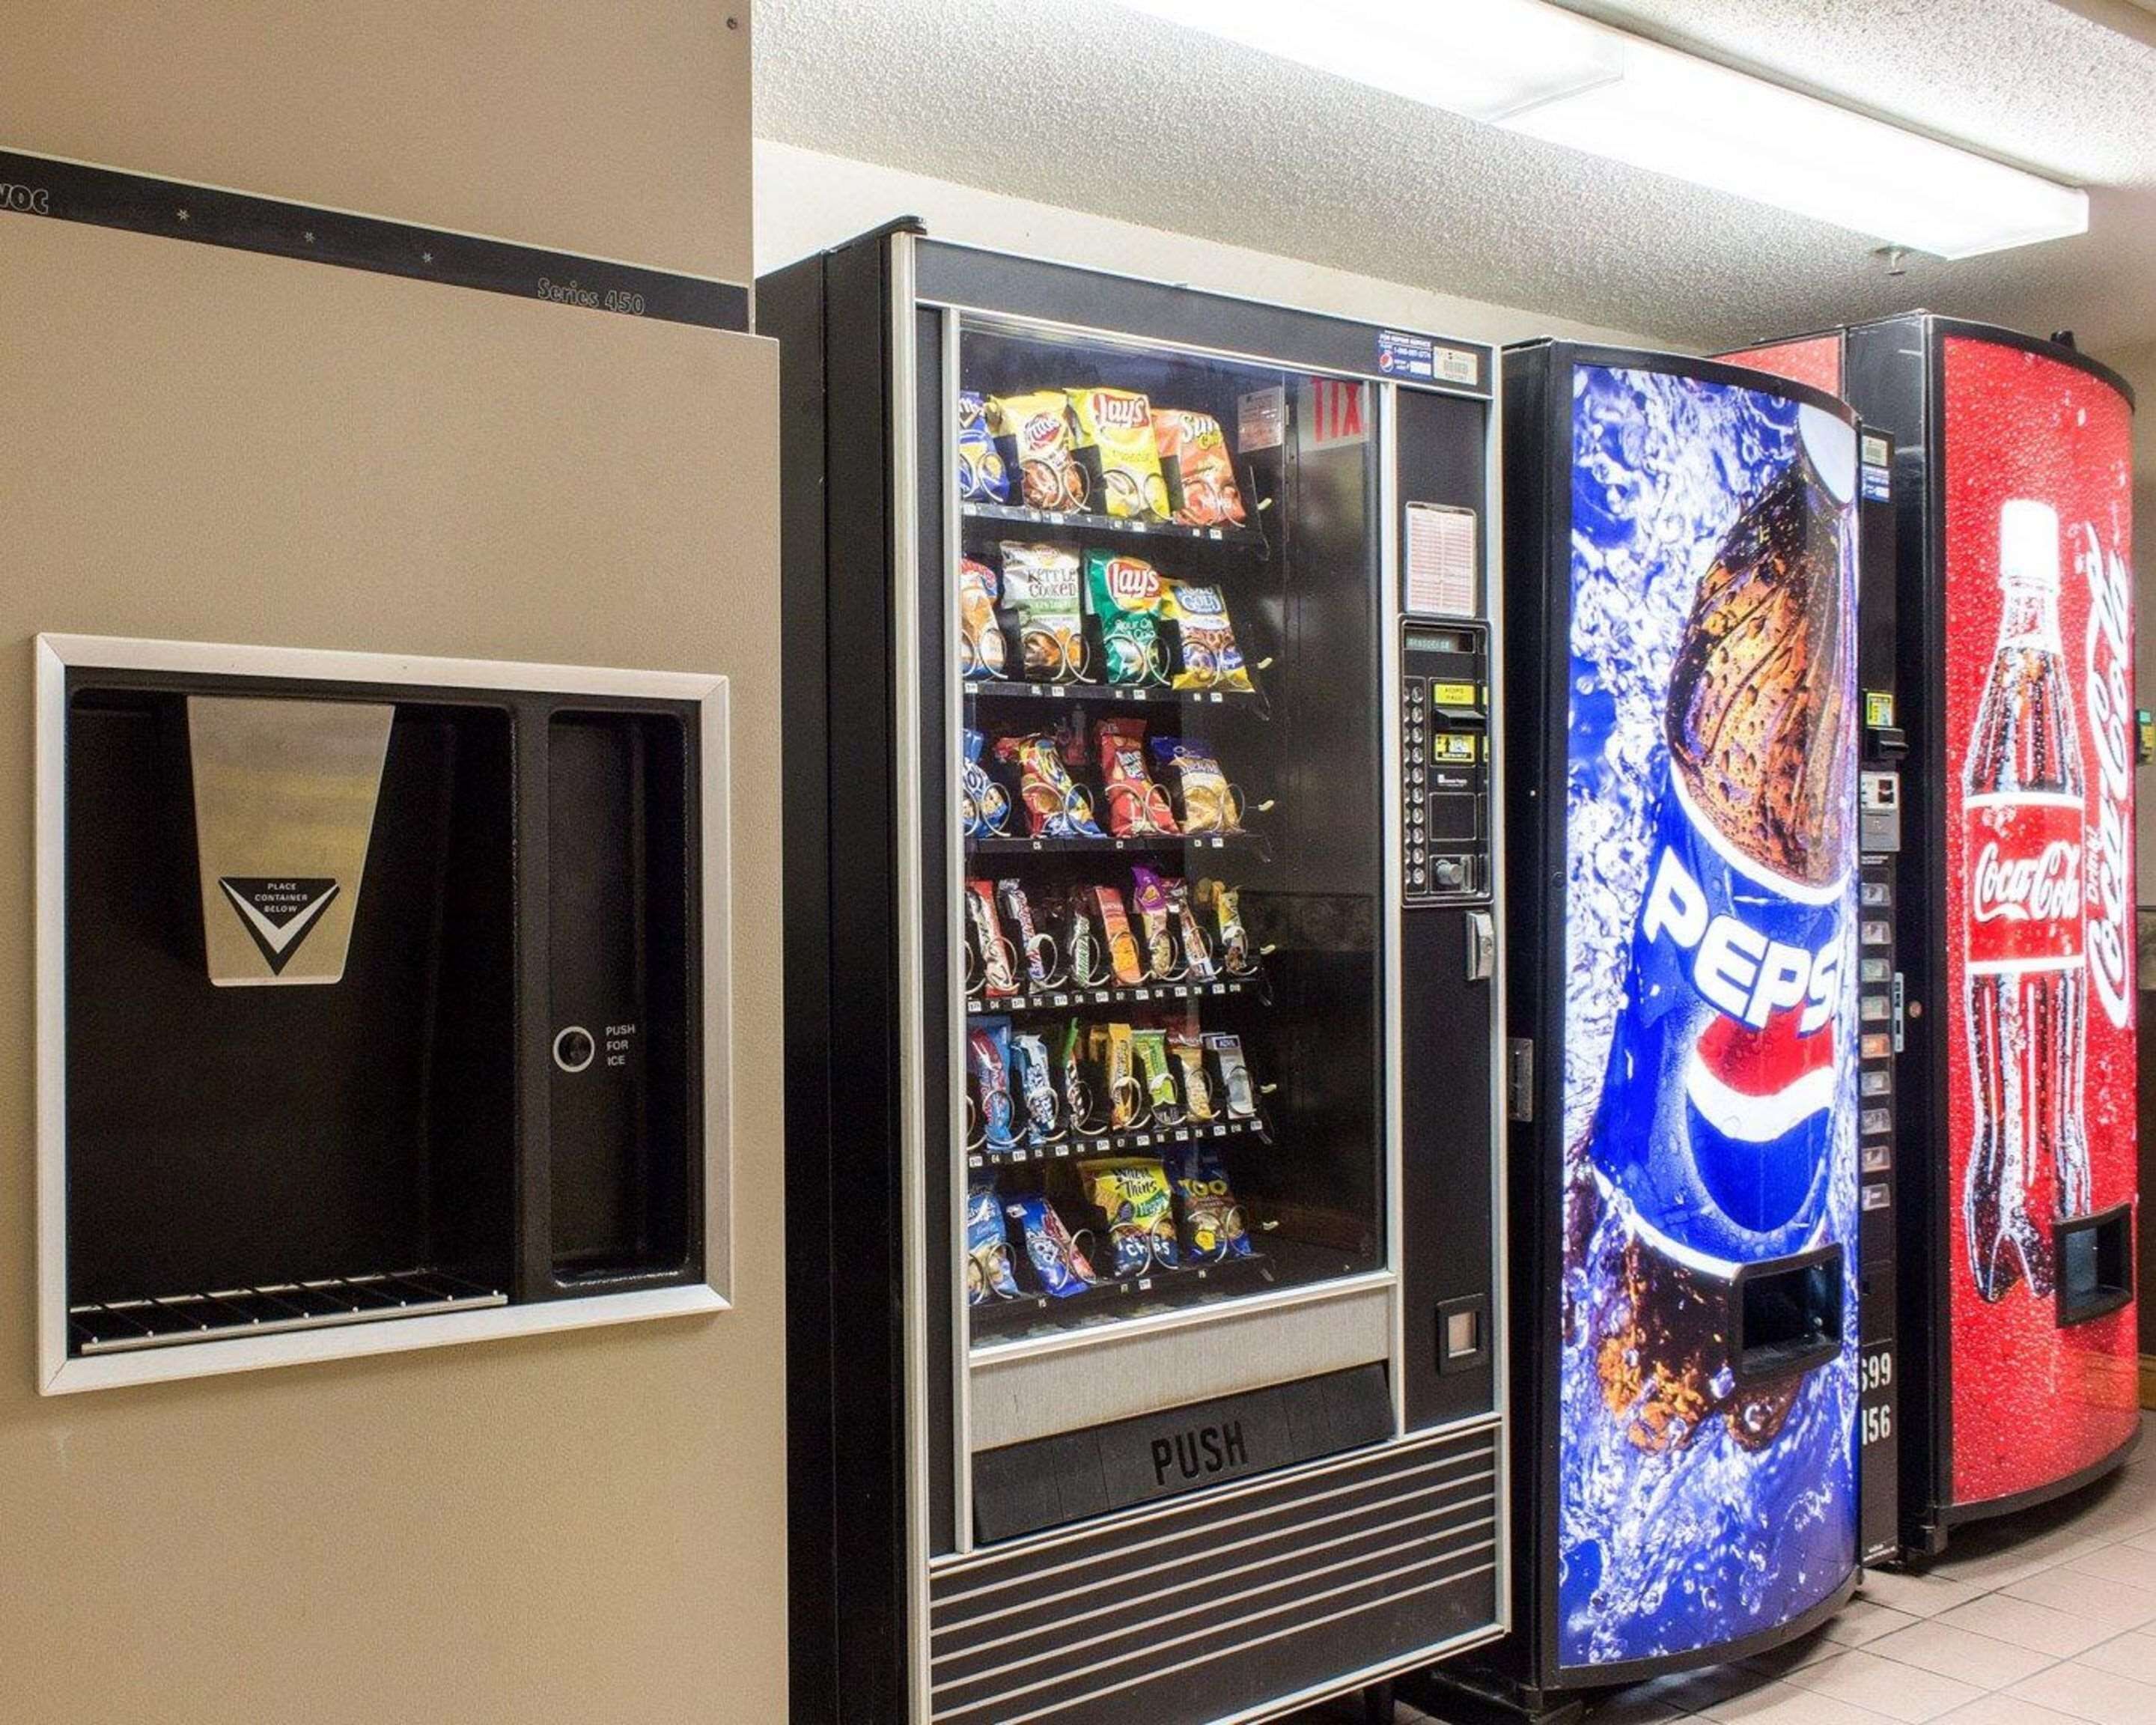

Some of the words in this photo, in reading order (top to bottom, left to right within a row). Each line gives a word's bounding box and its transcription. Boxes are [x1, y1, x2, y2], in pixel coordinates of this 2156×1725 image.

[538, 277, 599, 308] Series
[604, 290, 645, 315] 450
[1642, 844, 1844, 1033] PEPS
[605, 1023, 636, 1036] PUSH
[606, 1040, 629, 1051] FOR
[607, 1055, 626, 1066] ICE
[1862, 1404, 1891, 1446] 156
[1151, 1420, 1249, 1485] PUSH
